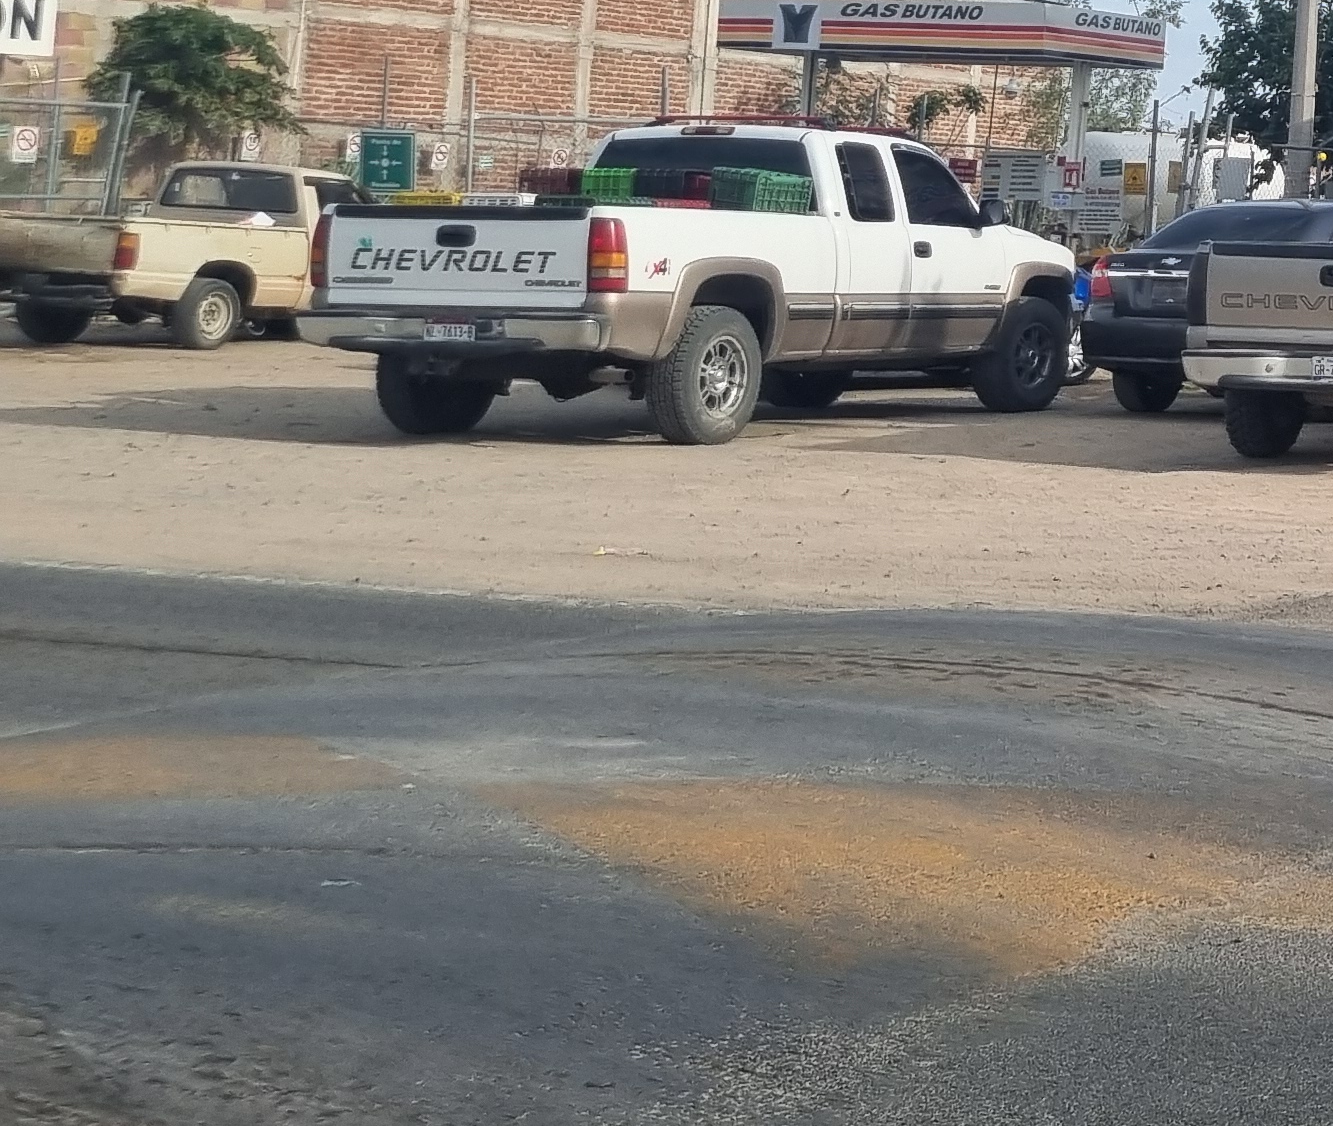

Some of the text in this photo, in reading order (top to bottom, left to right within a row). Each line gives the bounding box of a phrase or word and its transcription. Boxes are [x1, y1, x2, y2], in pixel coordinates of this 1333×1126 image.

[840, 2, 984, 21] GAS BUTANO
[1075, 12, 1161, 36] GAS BUTANO
[351, 248, 557, 274] CHEVROLET
